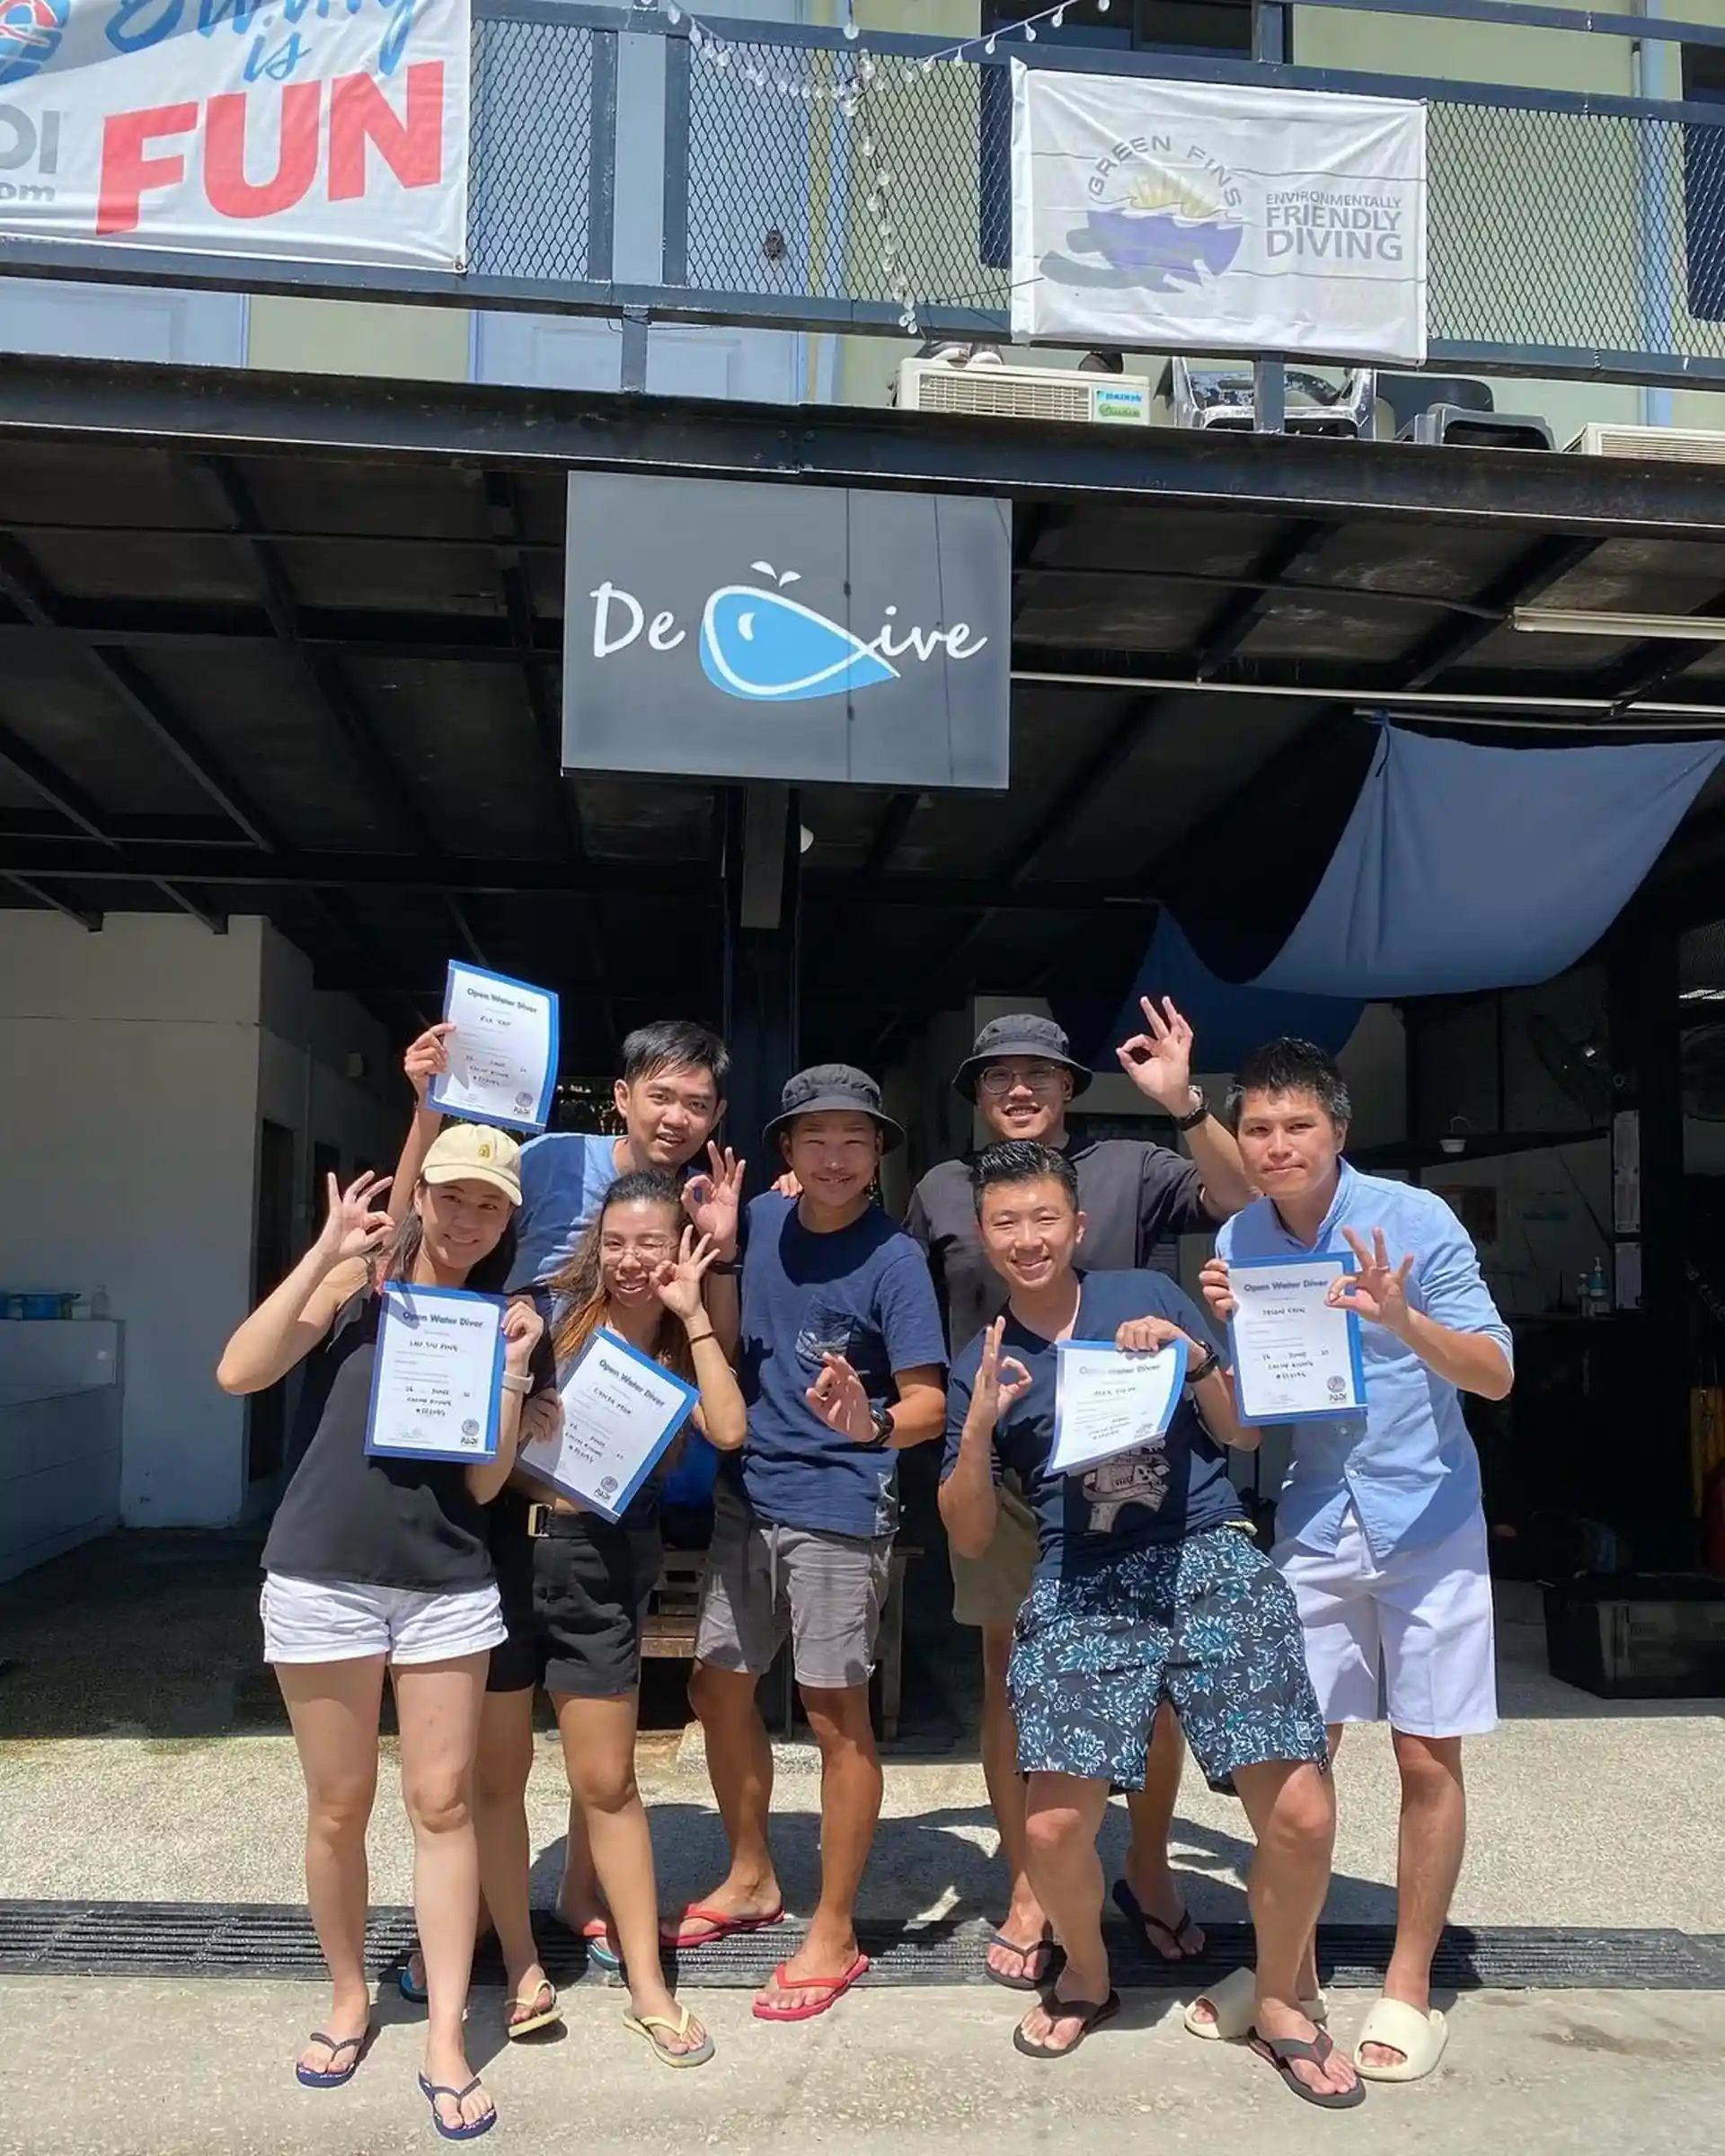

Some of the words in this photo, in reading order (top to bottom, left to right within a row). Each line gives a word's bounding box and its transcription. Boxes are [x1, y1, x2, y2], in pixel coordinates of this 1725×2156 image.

[243, 13, 313, 83] is
[96, 60, 445, 235] FUN
[1087, 135, 1172, 198] GREEN
[1186, 144, 1243, 209] FINS
[1266, 190, 1402, 208] ENVIRONMENTALLY
[1266, 203, 1402, 232] FRIENDLY
[1266, 227, 1403, 261] DIVING
[589, 580, 686, 658] De
[466, 987, 491, 1001] Open
[491, 994, 516, 1007] Water
[517, 1001, 538, 1013] Diver
[1243, 1283, 1270, 1293] Open
[1271, 1281, 1302, 1291] Water
[1303, 1278, 1329, 1288] Diver
[403, 1311, 428, 1323] Open
[429, 1313, 457, 1325] Water
[459, 1317, 484, 1329] Diver
[598, 1358, 620, 1378] Open
[620, 1372, 644, 1393] Water
[643, 1389, 665, 1408] Diver
